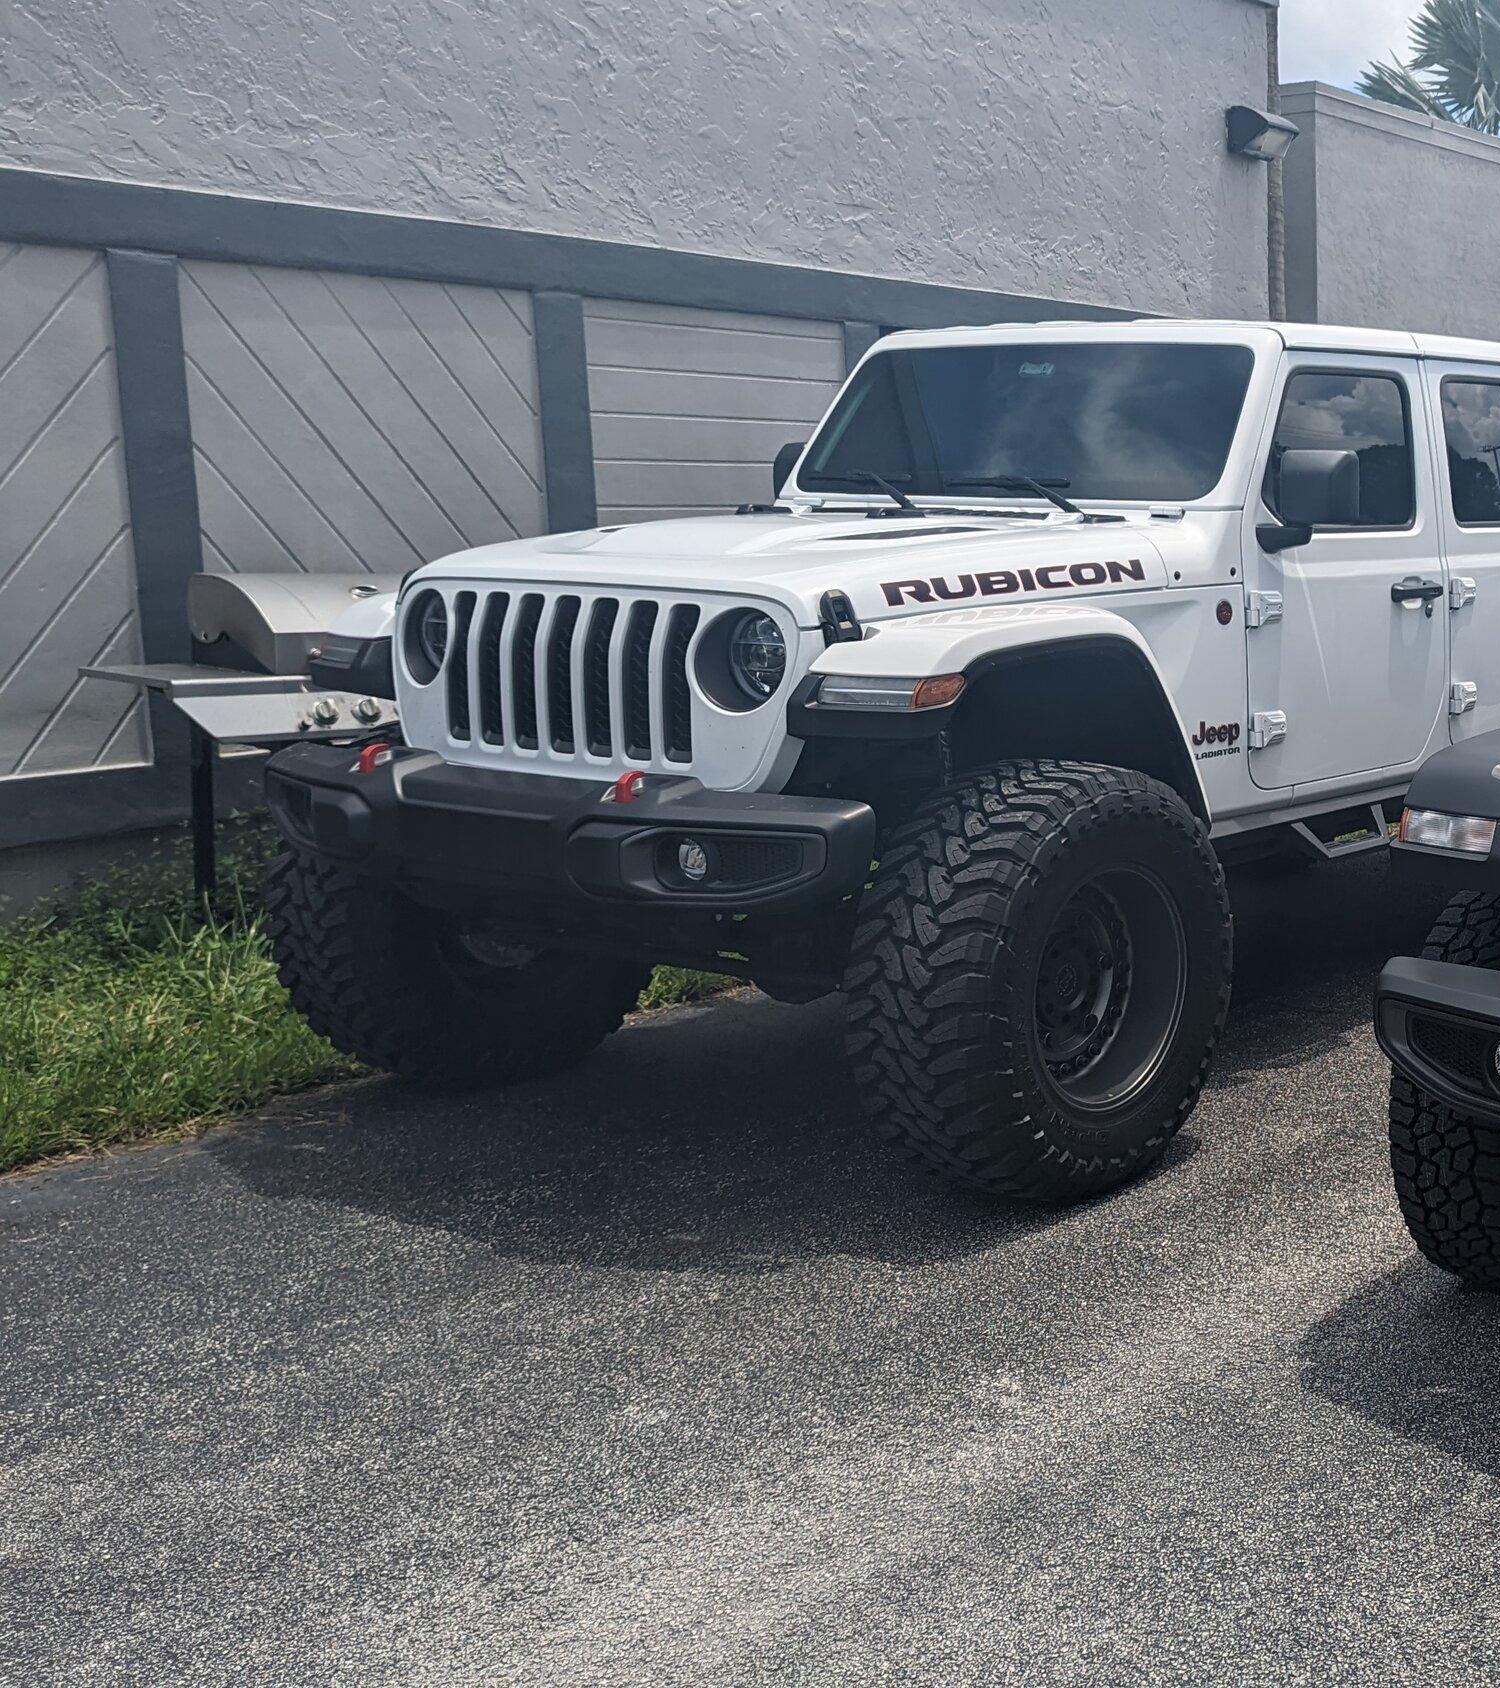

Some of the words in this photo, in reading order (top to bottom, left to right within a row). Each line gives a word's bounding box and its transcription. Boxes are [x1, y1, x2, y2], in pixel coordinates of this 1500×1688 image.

[879, 558, 1146, 607] RUBICON
[1192, 721, 1240, 746] Jeep
[1193, 746, 1241, 761] LADIATOR
